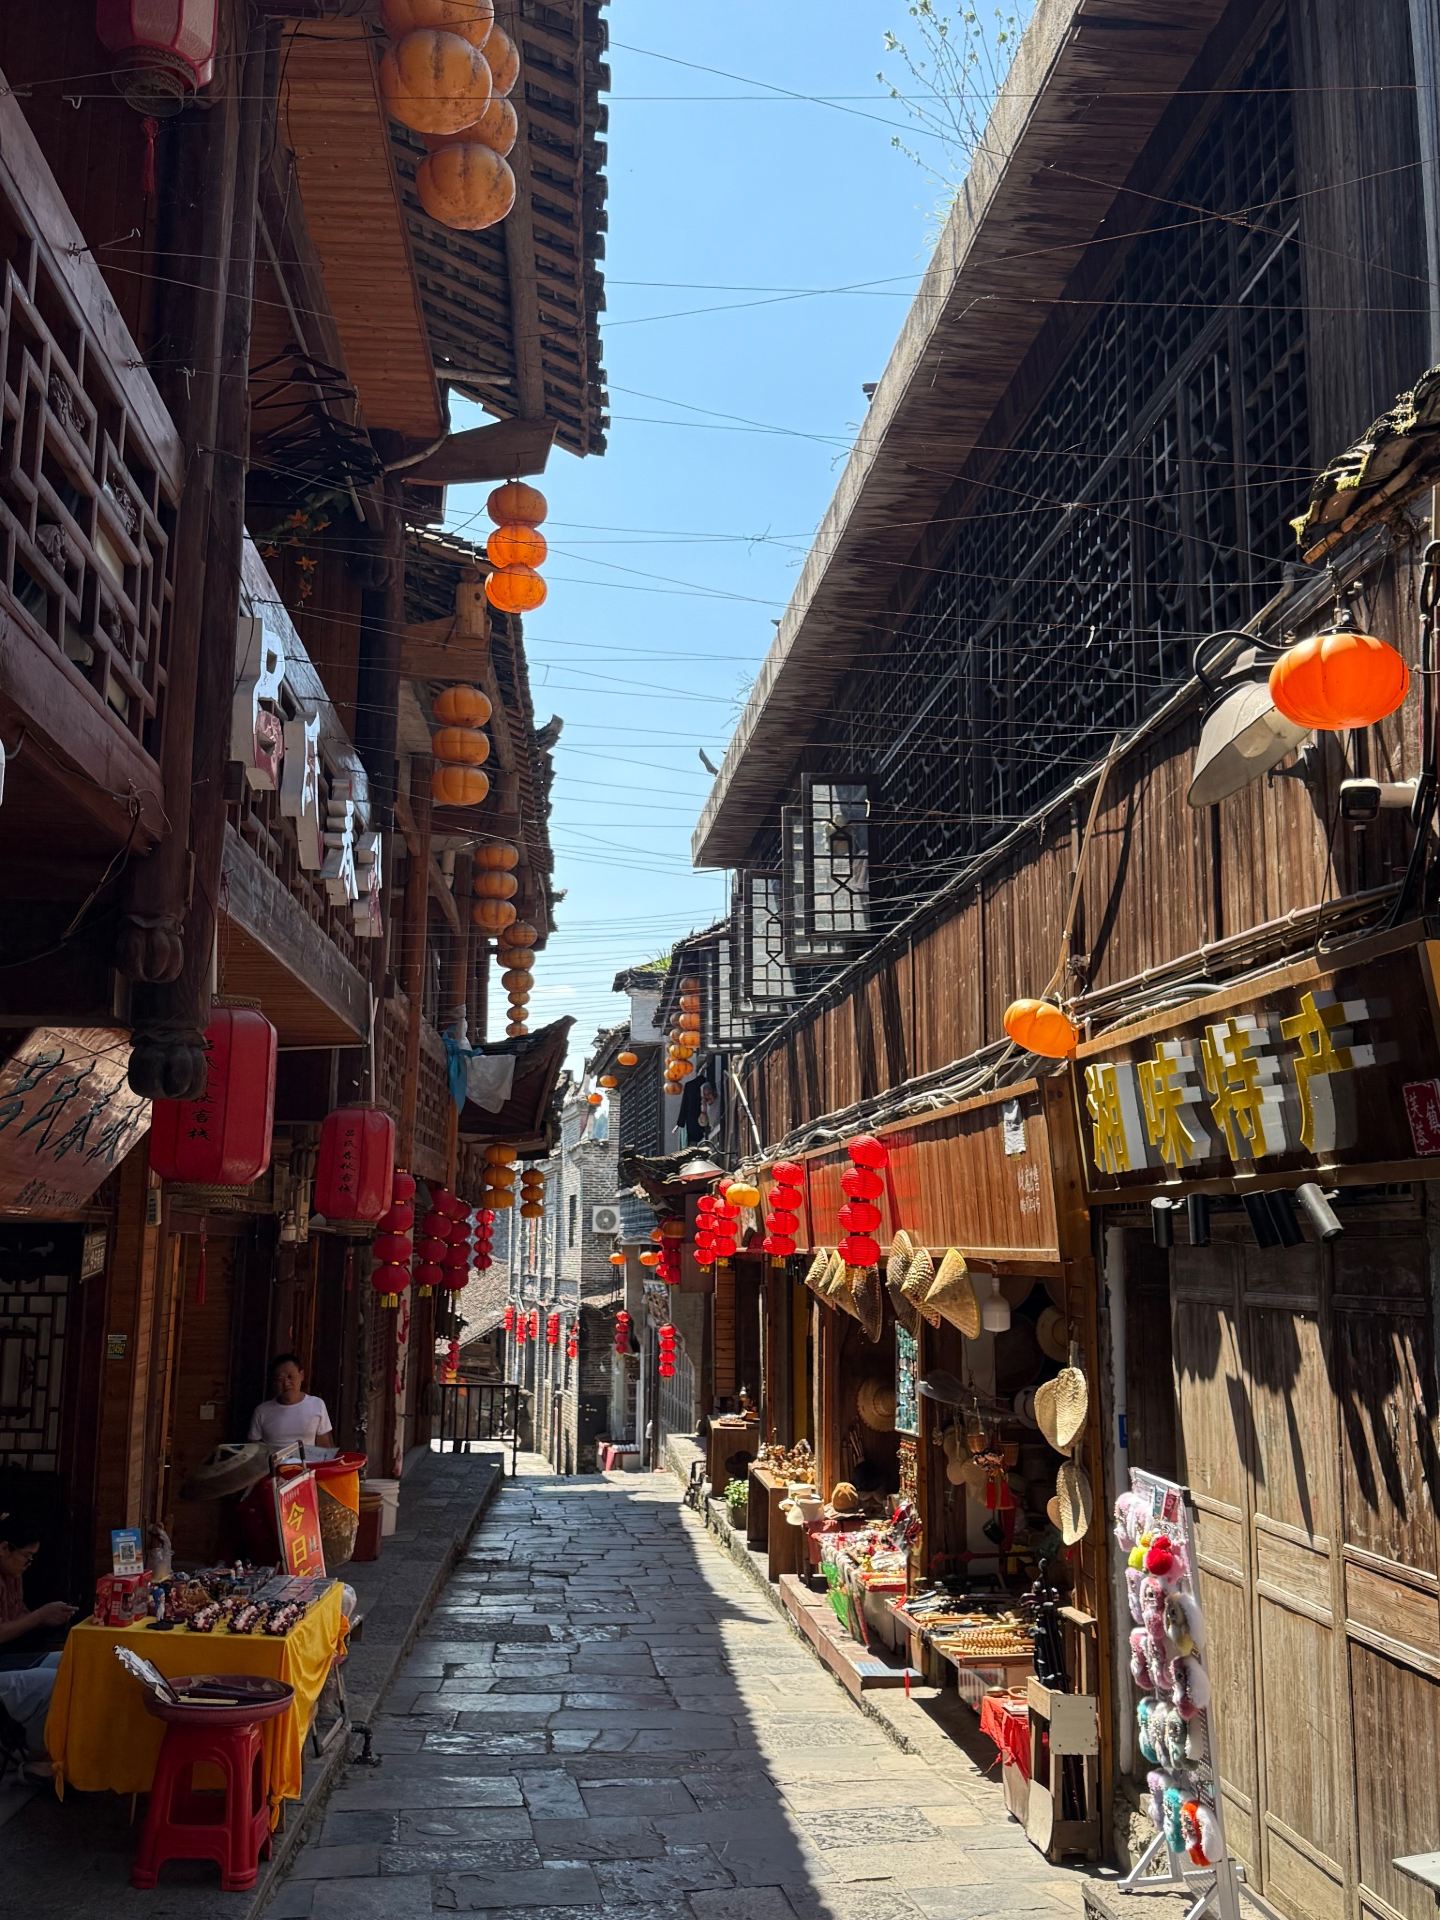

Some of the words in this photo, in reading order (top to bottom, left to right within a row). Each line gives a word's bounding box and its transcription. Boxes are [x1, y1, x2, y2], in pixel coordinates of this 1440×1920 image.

[1084, 991, 1358, 1174] 湘味特产
[287, 1501, 312, 1577] 今日
